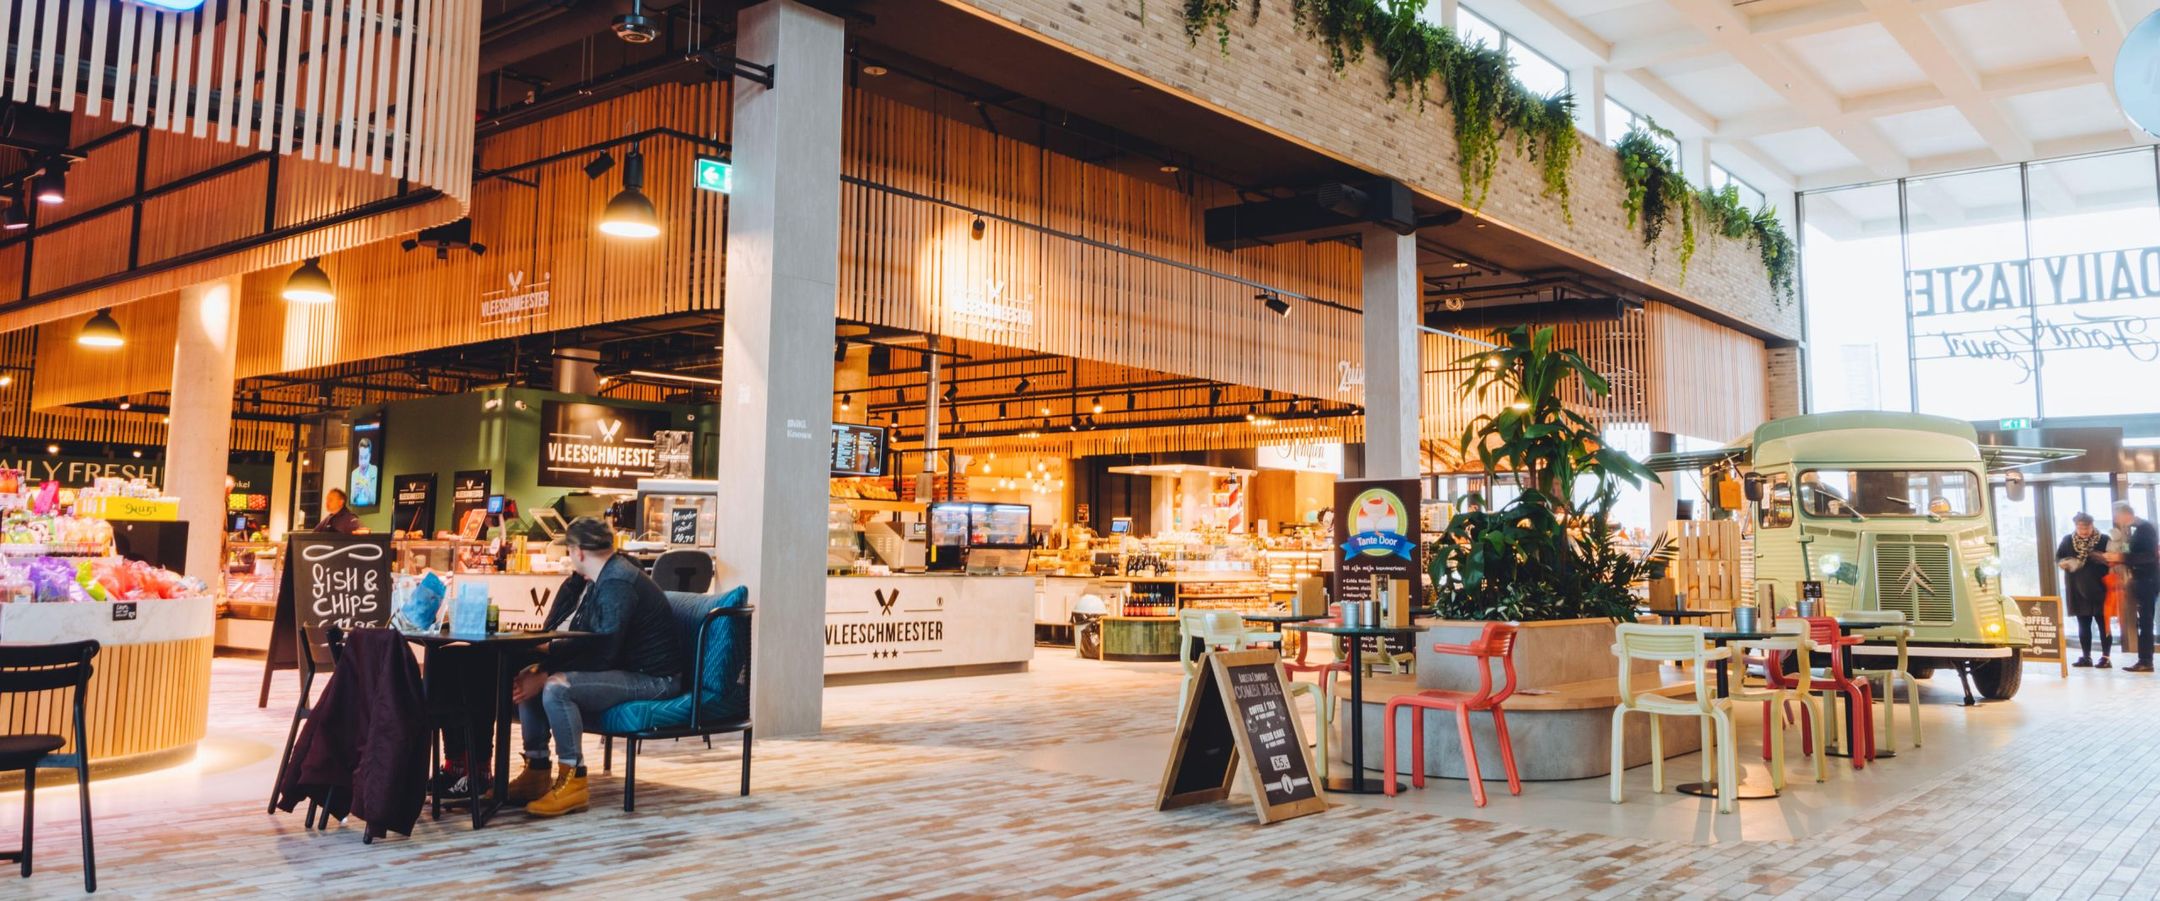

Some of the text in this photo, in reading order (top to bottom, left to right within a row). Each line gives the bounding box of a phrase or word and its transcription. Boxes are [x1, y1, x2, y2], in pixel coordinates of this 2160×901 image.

[482, 291, 549, 317] VLEESCHMEESTER
[548, 443, 656, 467] VLEESCHMEESTE
[1357, 534, 1397, 546] Tante Door
[825, 621, 943, 645] VLEESCHMEESTER
